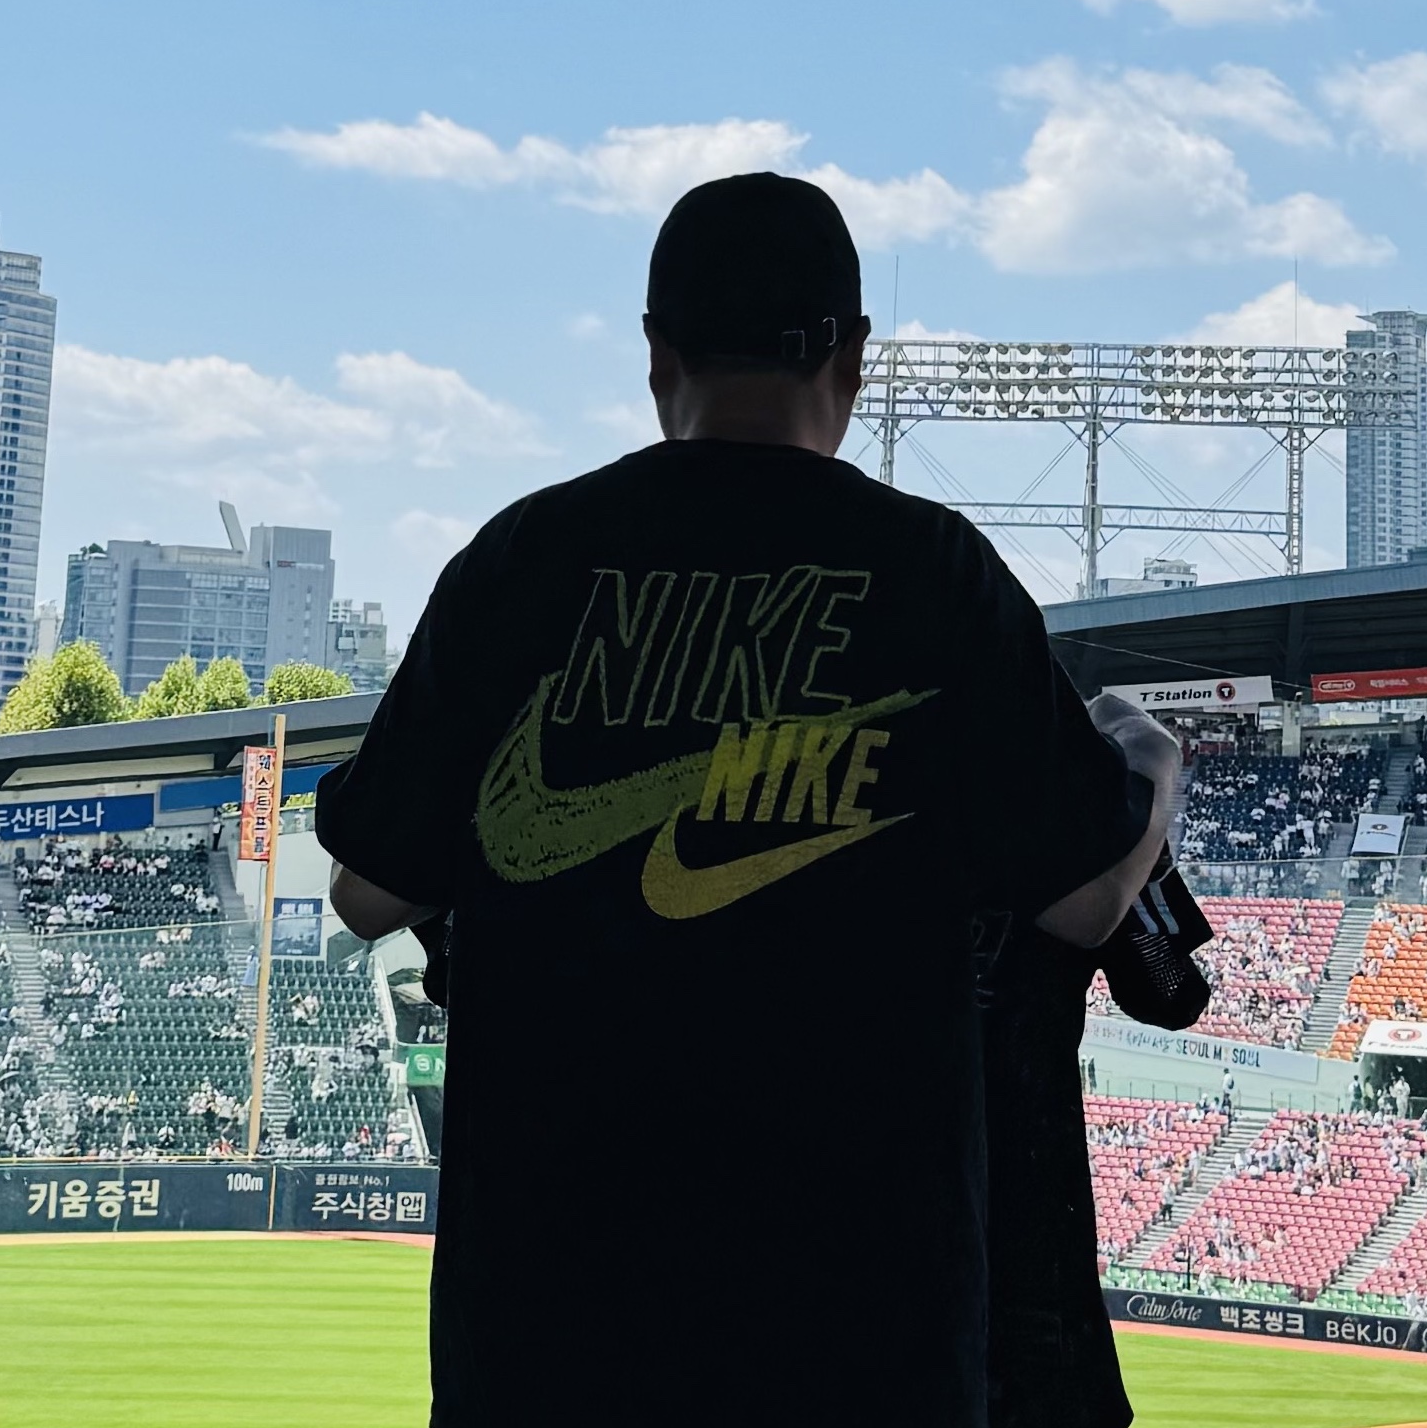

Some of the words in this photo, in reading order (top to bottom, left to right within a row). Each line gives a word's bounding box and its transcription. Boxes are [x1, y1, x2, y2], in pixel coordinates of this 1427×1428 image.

[551, 565, 872, 728] NIKE
[696, 722, 891, 827] NIKE
[27, 1179, 160, 1219] 키움증권
[227, 1173, 263, 1191] 100m
[1220, 1306, 1305, 1334] 백조씽크
